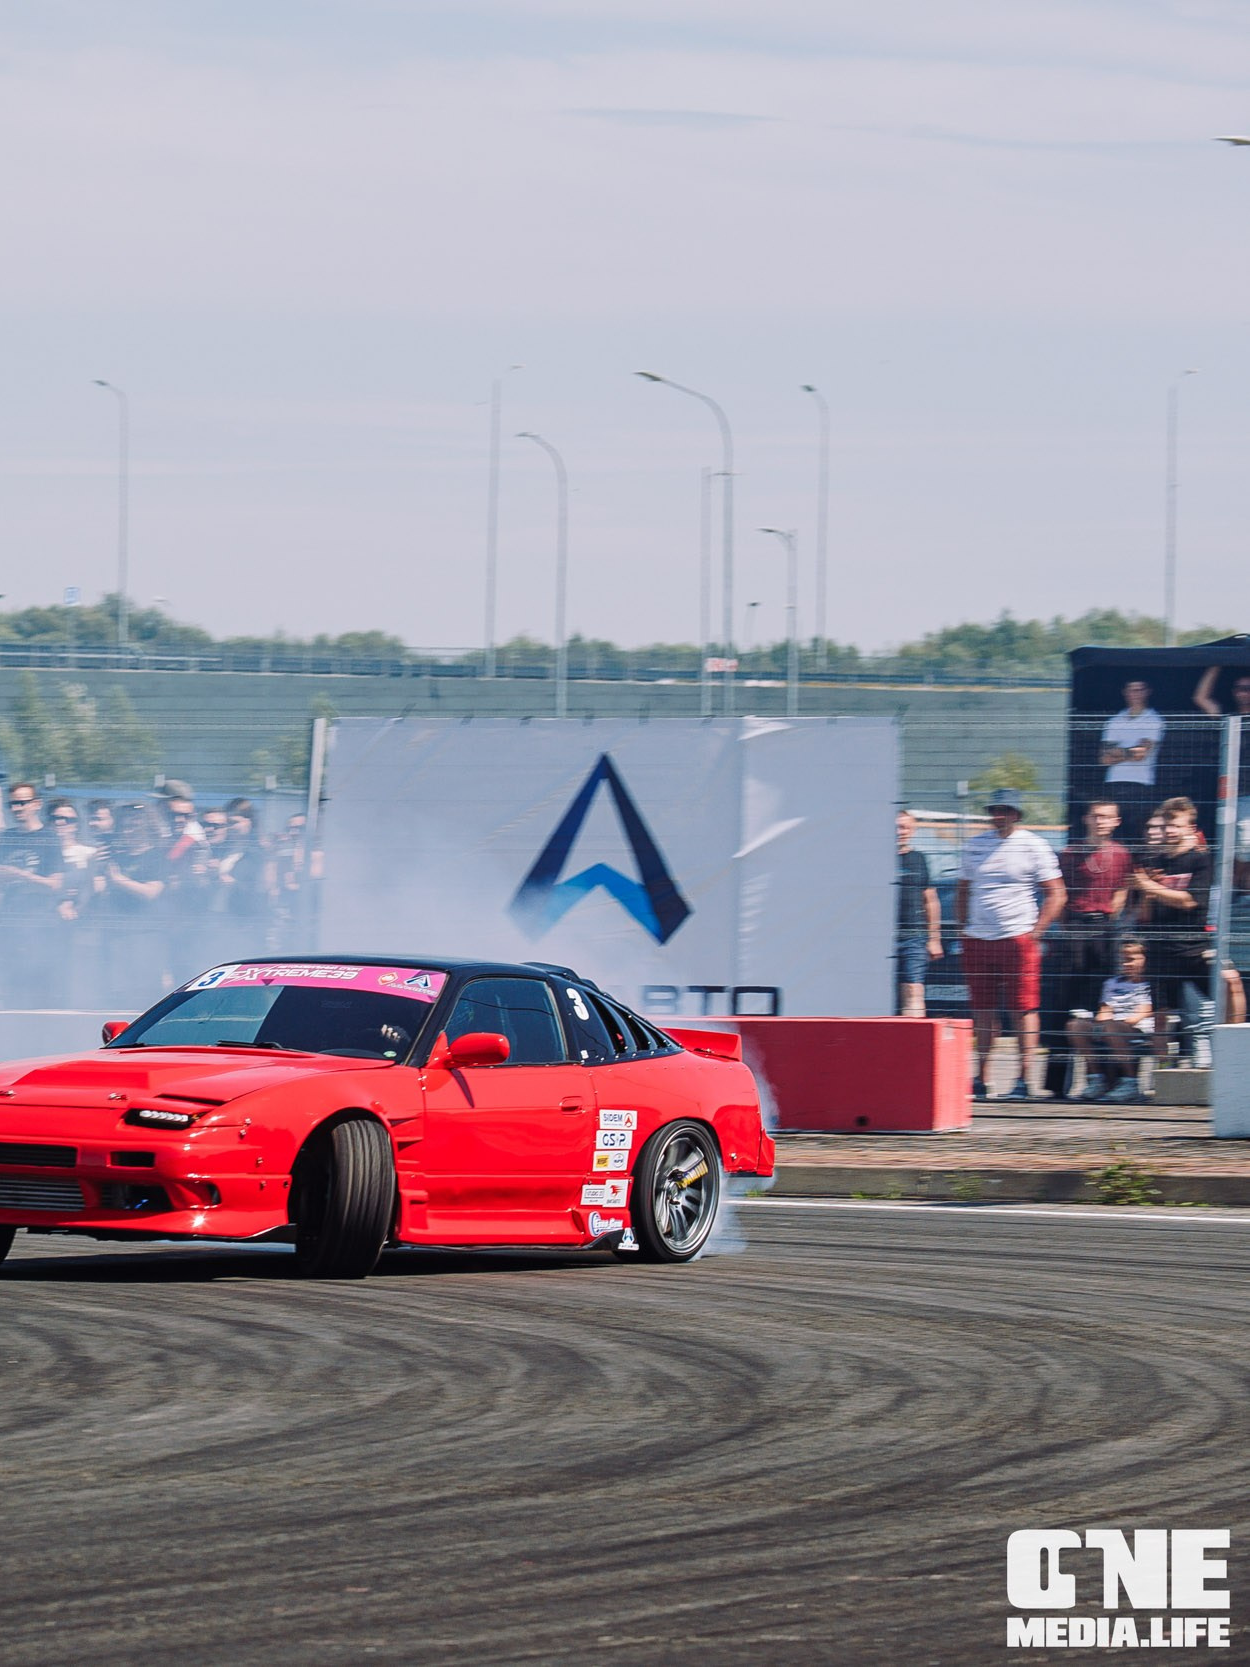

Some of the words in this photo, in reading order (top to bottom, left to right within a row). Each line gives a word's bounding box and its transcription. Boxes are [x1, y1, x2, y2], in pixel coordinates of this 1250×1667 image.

[197, 971, 223, 987] 3
[566, 987, 589, 1020] 3
[603, 1113, 623, 1122] SIDEM
